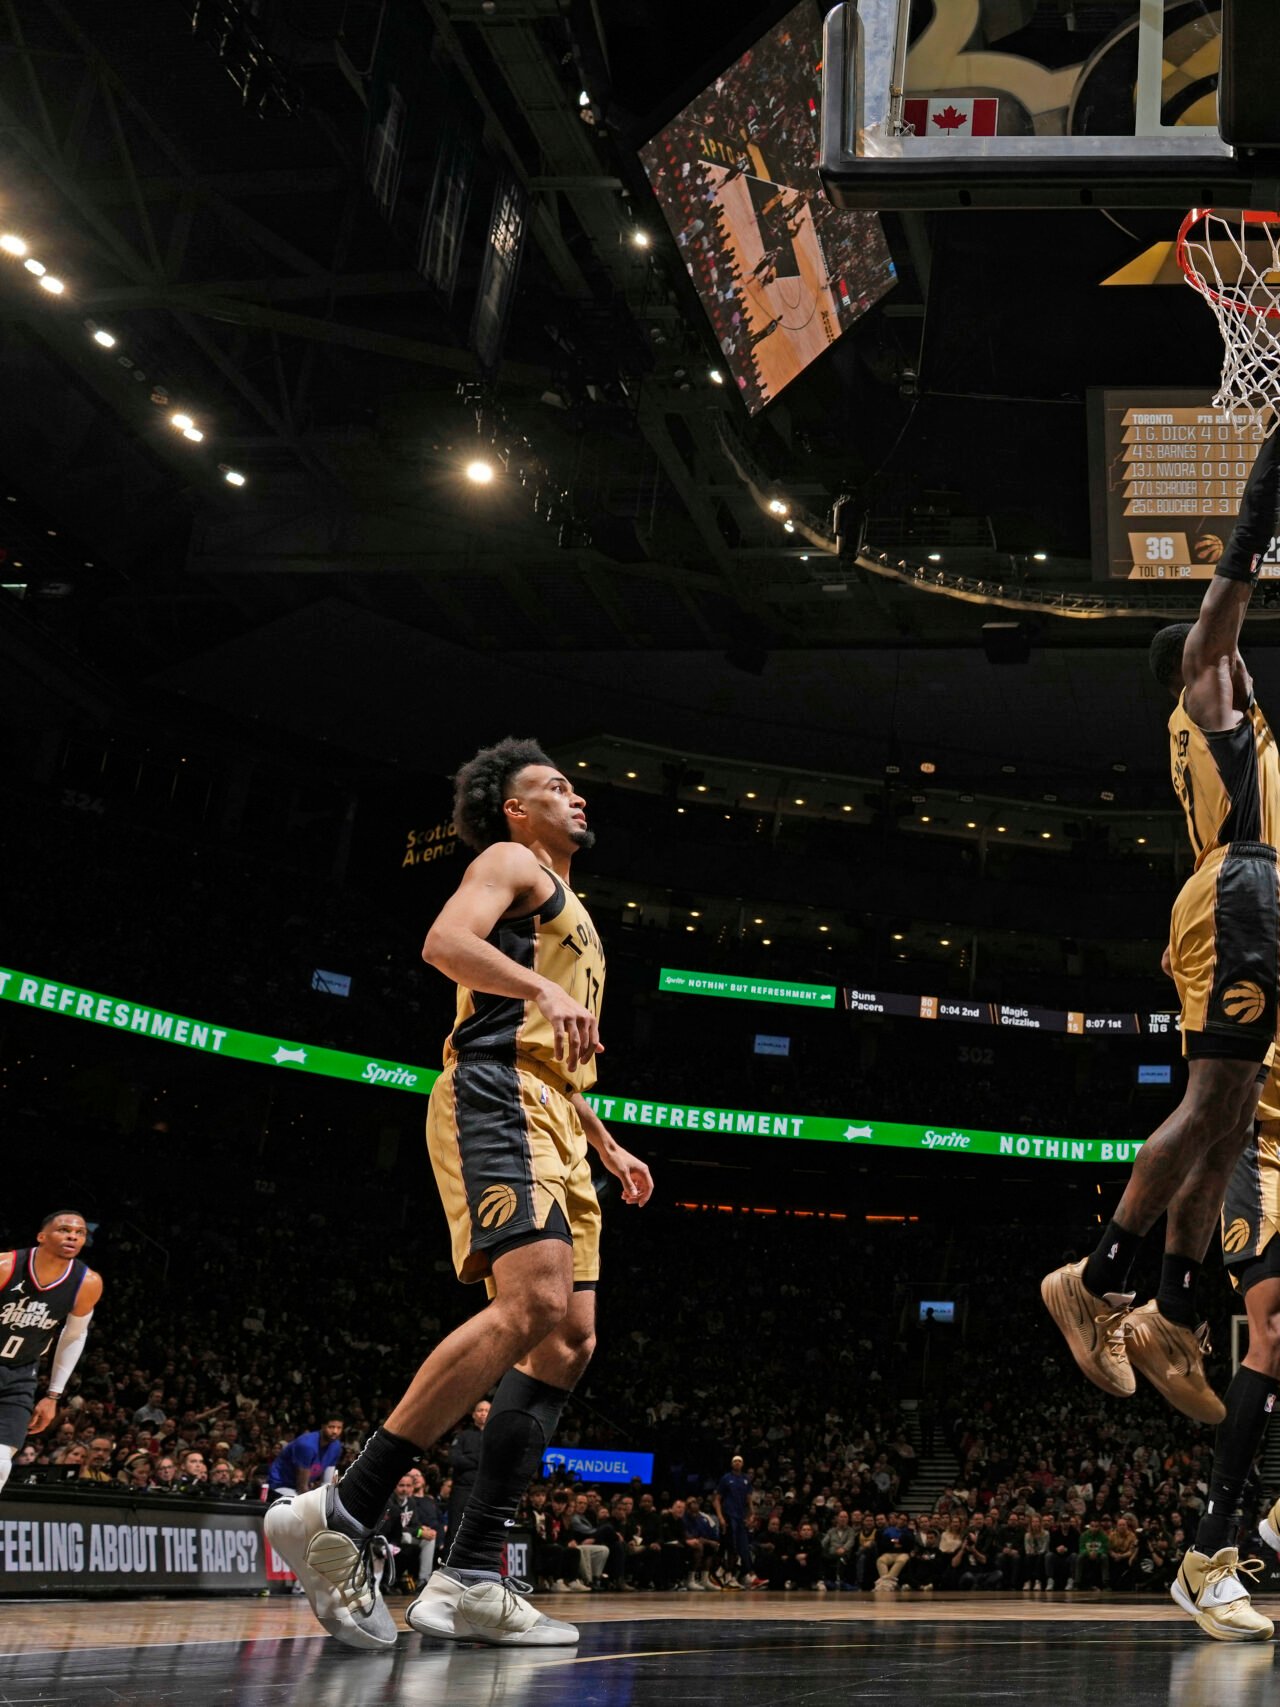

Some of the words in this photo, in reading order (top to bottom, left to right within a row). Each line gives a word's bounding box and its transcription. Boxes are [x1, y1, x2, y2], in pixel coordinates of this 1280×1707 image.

[1132, 414, 1174, 424] TORONTO
[1197, 414, 1213, 424] PTS
[1134, 426, 1141, 440] 1
[1146, 426, 1158, 440] G.
[1162, 426, 1196, 440] DICK
[1201, 426, 1211, 440] 4
[1218, 426, 1228, 440] 0
[1252, 426, 1262, 440] 2
[1132, 444, 1142, 459] 4
[1146, 444, 1155, 459] S.
[1157, 444, 1197, 459] BARNES
[1201, 444, 1211, 459] 7
[1219, 444, 1227, 459] 1
[1237, 444, 1244, 459] 1
[1131, 463, 1145, 477] 13
[1146, 463, 1154, 477] J.
[1156, 463, 1197, 477] NWORA
[1202, 463, 1212, 477] 0
[1218, 463, 1229, 477] 0
[1235, 463, 1246, 477] 0
[1132, 481, 1146, 495] 17
[1202, 481, 1212, 495] 7
[1220, 481, 1227, 495] 1
[1235, 481, 1245, 495] 2
[1132, 499, 1146, 513] 25
[1157, 499, 1198, 513] BOUCHER
[1202, 499, 1212, 513] 2
[1220, 499, 1229, 513] 3
[1145, 536, 1175, 560] 36
[1140, 565, 1156, 577] TOL
[1158, 566, 1164, 577] 6
[405, 818, 458, 849] Scotia
[401, 840, 456, 868] Arena
[688, 979, 728, 990] NOTHIN'
[730, 984, 748, 993] BUT
[750, 986, 818, 1000] REFRESHMENT
[851, 991, 876, 1001] Suns
[19, 978, 227, 1051] REFRESHMENT
[851, 1001, 884, 1012] Pacers
[940, 1005, 960, 1015] 0:04
[962, 1007, 980, 1017] 2nd
[1001, 1006, 1029, 1017] Magic
[1001, 1016, 1040, 1028] Grizzlies
[1085, 1019, 1105, 1029] 8:07
[1107, 1019, 1122, 1029] 1st
[1160, 1023, 1167, 1033] 6
[957, 1046, 995, 1065] 302
[361, 1062, 418, 1088] Sprite
[623, 1101, 804, 1137] REFRESHMENT
[921, 1130, 971, 1148] Sprite
[999, 1135, 1093, 1160] NOTHIN'
[18, 1296, 48, 1315] Los
[0, 1302, 58, 1330] Angele
[0, 1335, 25, 1359] 0
[567, 1458, 629, 1475] FANDUEL
[89, 1523, 158, 1573] ABOUT
[161, 1527, 198, 1573] THE
[201, 1528, 258, 1574] RAPS?
[506, 1543, 528, 1577] BET
